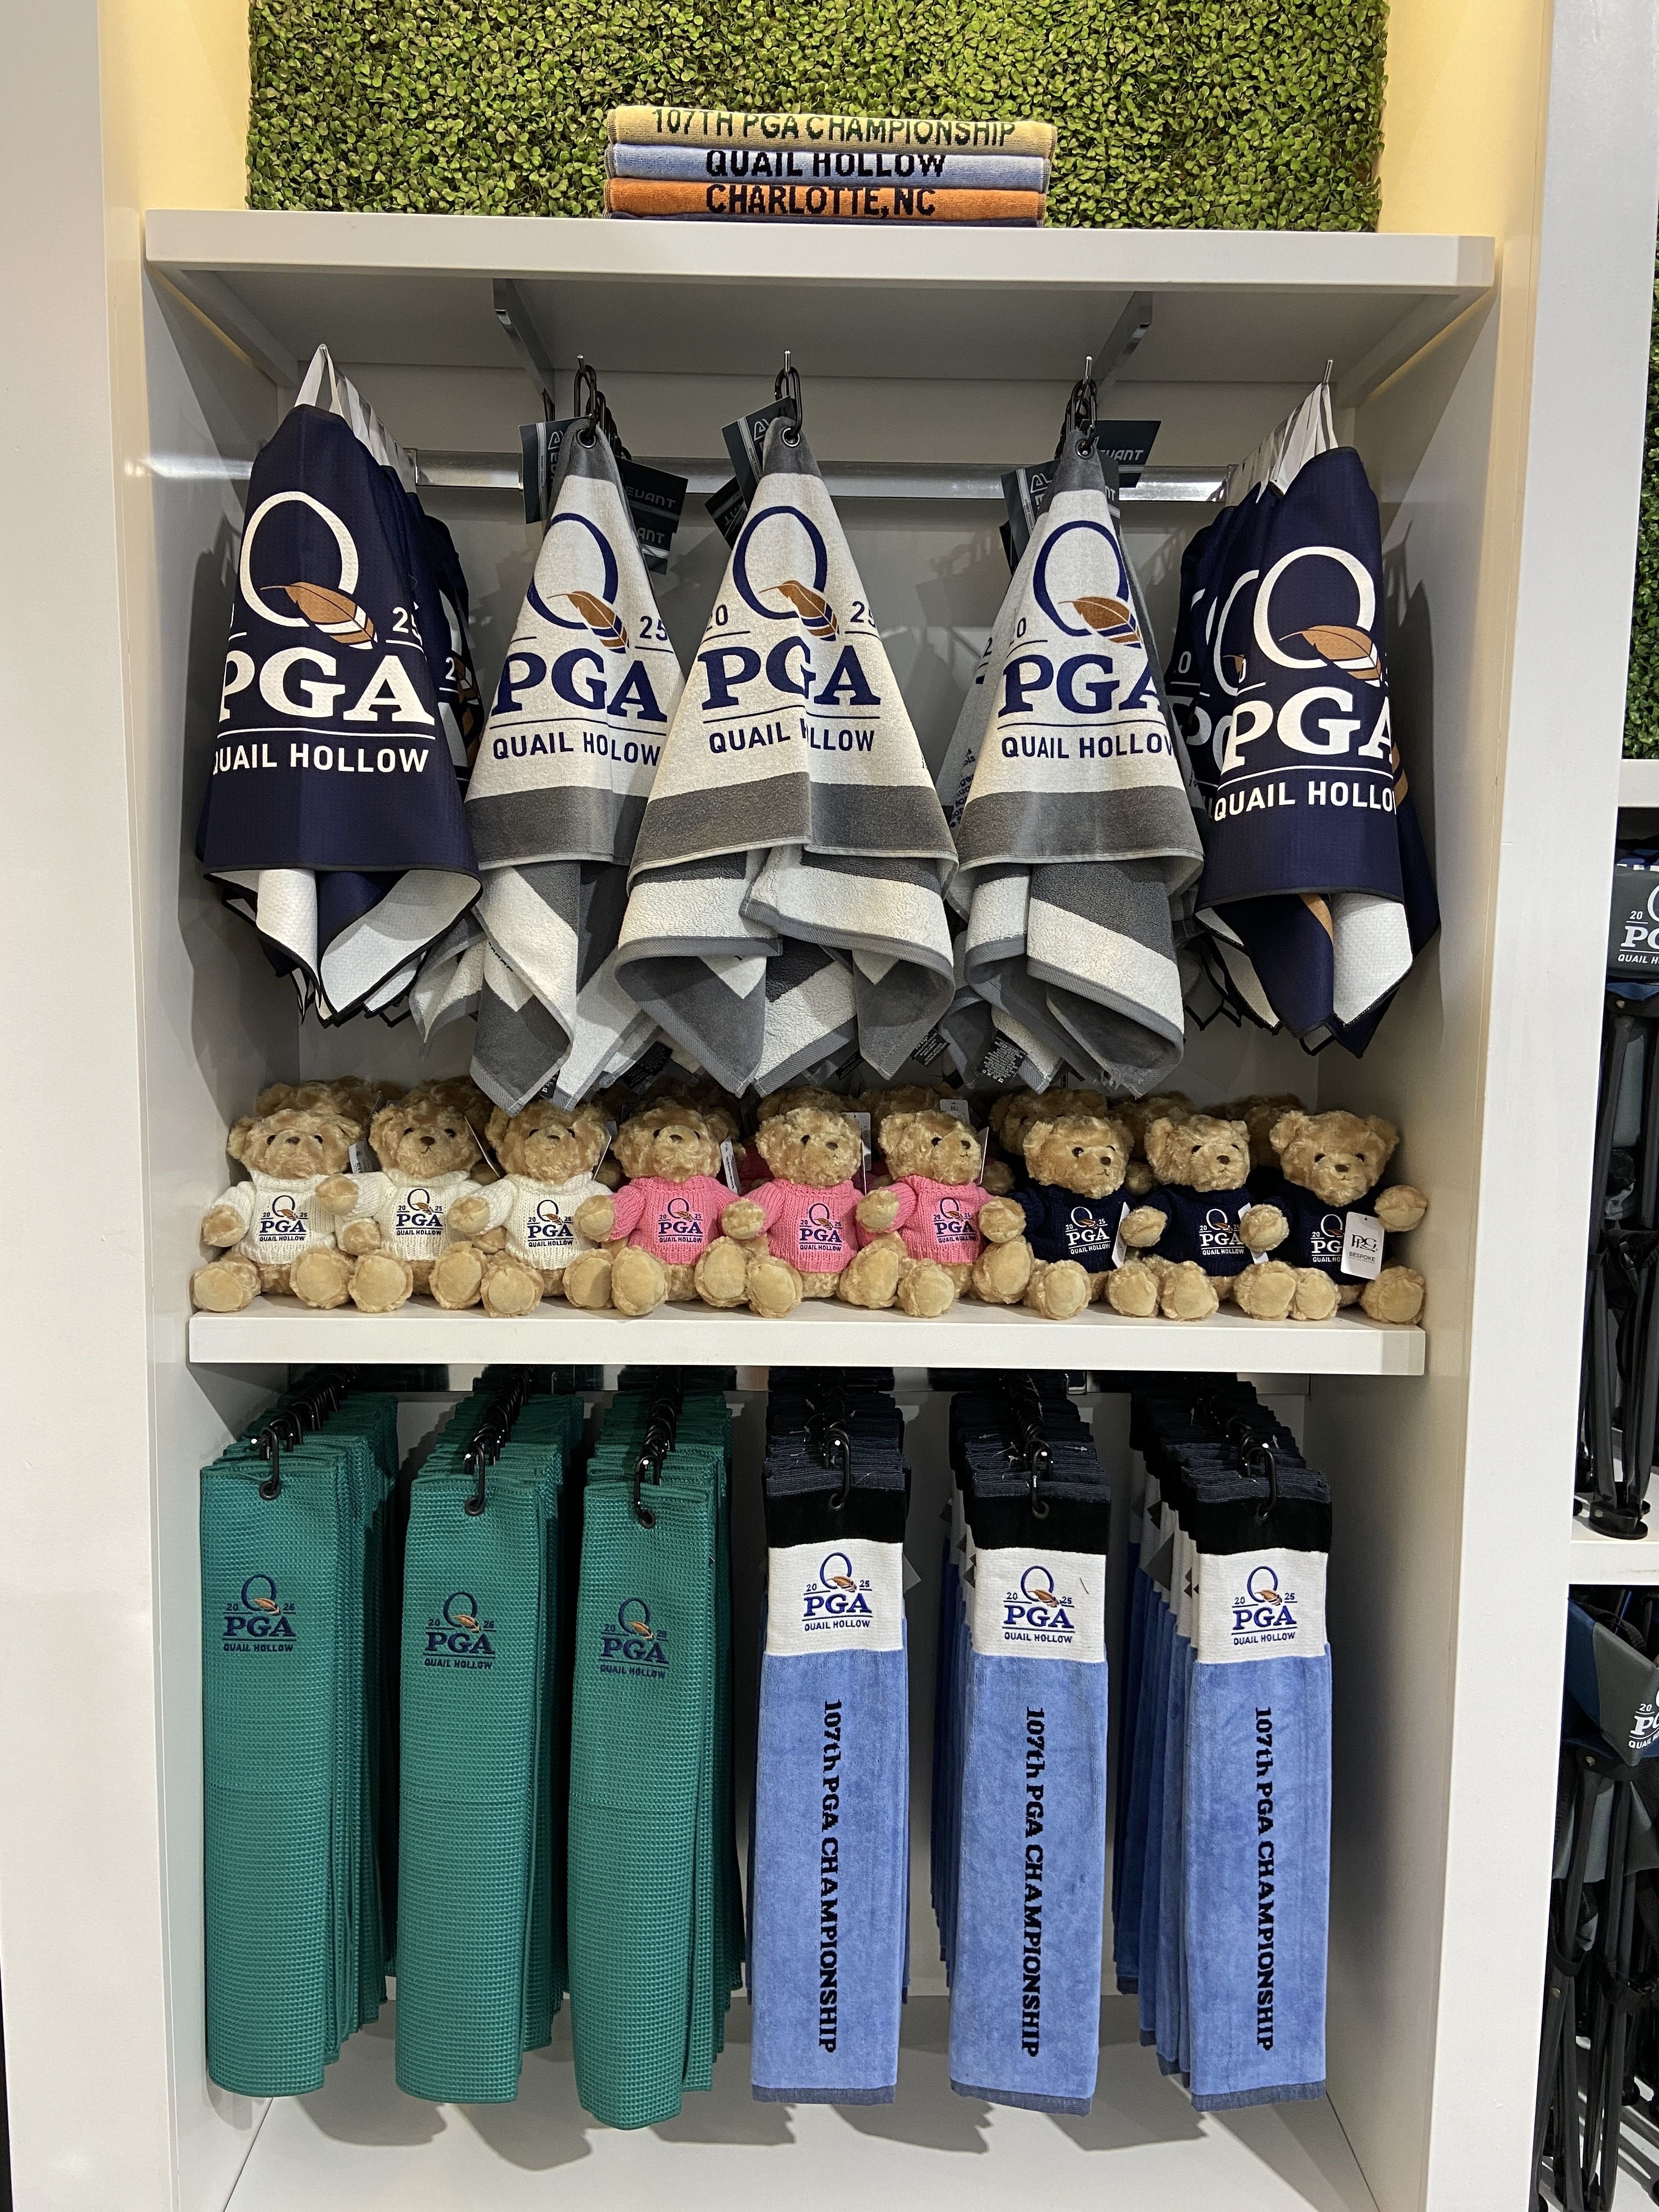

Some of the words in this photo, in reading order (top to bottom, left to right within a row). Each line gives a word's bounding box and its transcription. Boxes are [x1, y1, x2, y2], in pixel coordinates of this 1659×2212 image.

[652, 109, 733, 136] 107TH
[743, 114, 798, 140] PGA
[810, 116, 1015, 147] CHAMPIONSHIP
[706, 149, 804, 178] QUAIL
[812, 151, 946, 178] HOLLOW
[625, 485, 676, 509] EVANT
[640, 616, 668, 641] 25
[697, 636, 881, 710] PGA
[219, 647, 435, 726] PGA
[492, 648, 667, 723] PGA
[998, 654, 1161, 718] PGA
[709, 722, 791, 754] QUAIL
[1221, 686, 1392, 775] PGA
[493, 732, 574, 760] QUAIL
[1002, 737, 1069, 759] QUAIL
[290, 743, 429, 772] HOLLOW
[1214, 782, 1295, 822] QUAIL
[1308, 782, 1396, 815] HOLLO
[1629, 911, 1643, 920] 20
[1618, 954, 1648, 964] QUAIL
[259, 1220, 307, 1234] PGA
[396, 1214, 443, 1227] PGA
[528, 1223, 573, 1239] PGA
[658, 1221, 703, 1235] PGA
[935, 1220, 977, 1235] PGA
[799, 1228, 843, 1244] PGA
[1067, 1228, 1110, 1246] PGA
[1200, 1233, 1242, 1247] PGA
[1070, 1246, 1088, 1255] QUAIL
[1088, 1243, 1111, 1252] HOLLOW
[1311, 1240, 1343, 1254] PG
[1349, 1251, 1376, 1262] BESPOKE
[806, 1583, 817, 1592] 20
[859, 1579, 870, 1588] 25
[227, 1603, 239, 1612] 20
[803, 1593, 872, 1617] PGA
[1006, 1592, 1018, 1600] 20
[1061, 1596, 1073, 1605] 25
[1234, 1596, 1245, 1605] 20
[1284, 1592, 1295, 1600] 25
[222, 1616, 296, 1637] PGA
[428, 1618, 440, 1627] 20
[483, 1620, 495, 1629] 25
[804, 1621, 831, 1632] QUAIL
[833, 1620, 871, 1628] HOLLOW
[1003, 1605, 1075, 1629] PGA
[1232, 1605, 1297, 1630] PGA
[604, 1623, 616, 1633] 20
[1004, 1632, 1031, 1642] QUAIL
[1034, 1634, 1073, 1644] HOLLOW
[1234, 1635, 1259, 1646] QUAIL
[1261, 1631, 1296, 1643] HOLLOW
[223, 1643, 251, 1652] QUAIL
[253, 1644, 294, 1652] HOLLOW
[424, 1632, 496, 1655] PGA
[601, 1637, 669, 1665] PGA
[424, 1658, 452, 1668] QUAIL
[454, 1659, 493, 1671] HOLLOW
[629, 1667, 666, 1679] HOLLOW
[1639, 1703, 1653, 1712] 20
[823, 1700, 842, 1772] 107th
[1026, 1706, 1045, 1781] 107th
[1255, 1706, 1274, 1778] 107th
[1628, 1736, 1652, 1750] QUAIL
[822, 1774, 840, 1833] PGA
[1025, 1783, 1044, 1839] PGA
[1256, 1780, 1274, 1836] PGA
[819, 1836, 839, 2054] CHAMPIONSHIP
[1022, 1844, 1043, 2057] CHAMPIONSHIP
[1257, 1840, 1275, 2051] CHAMPIONSHIP
